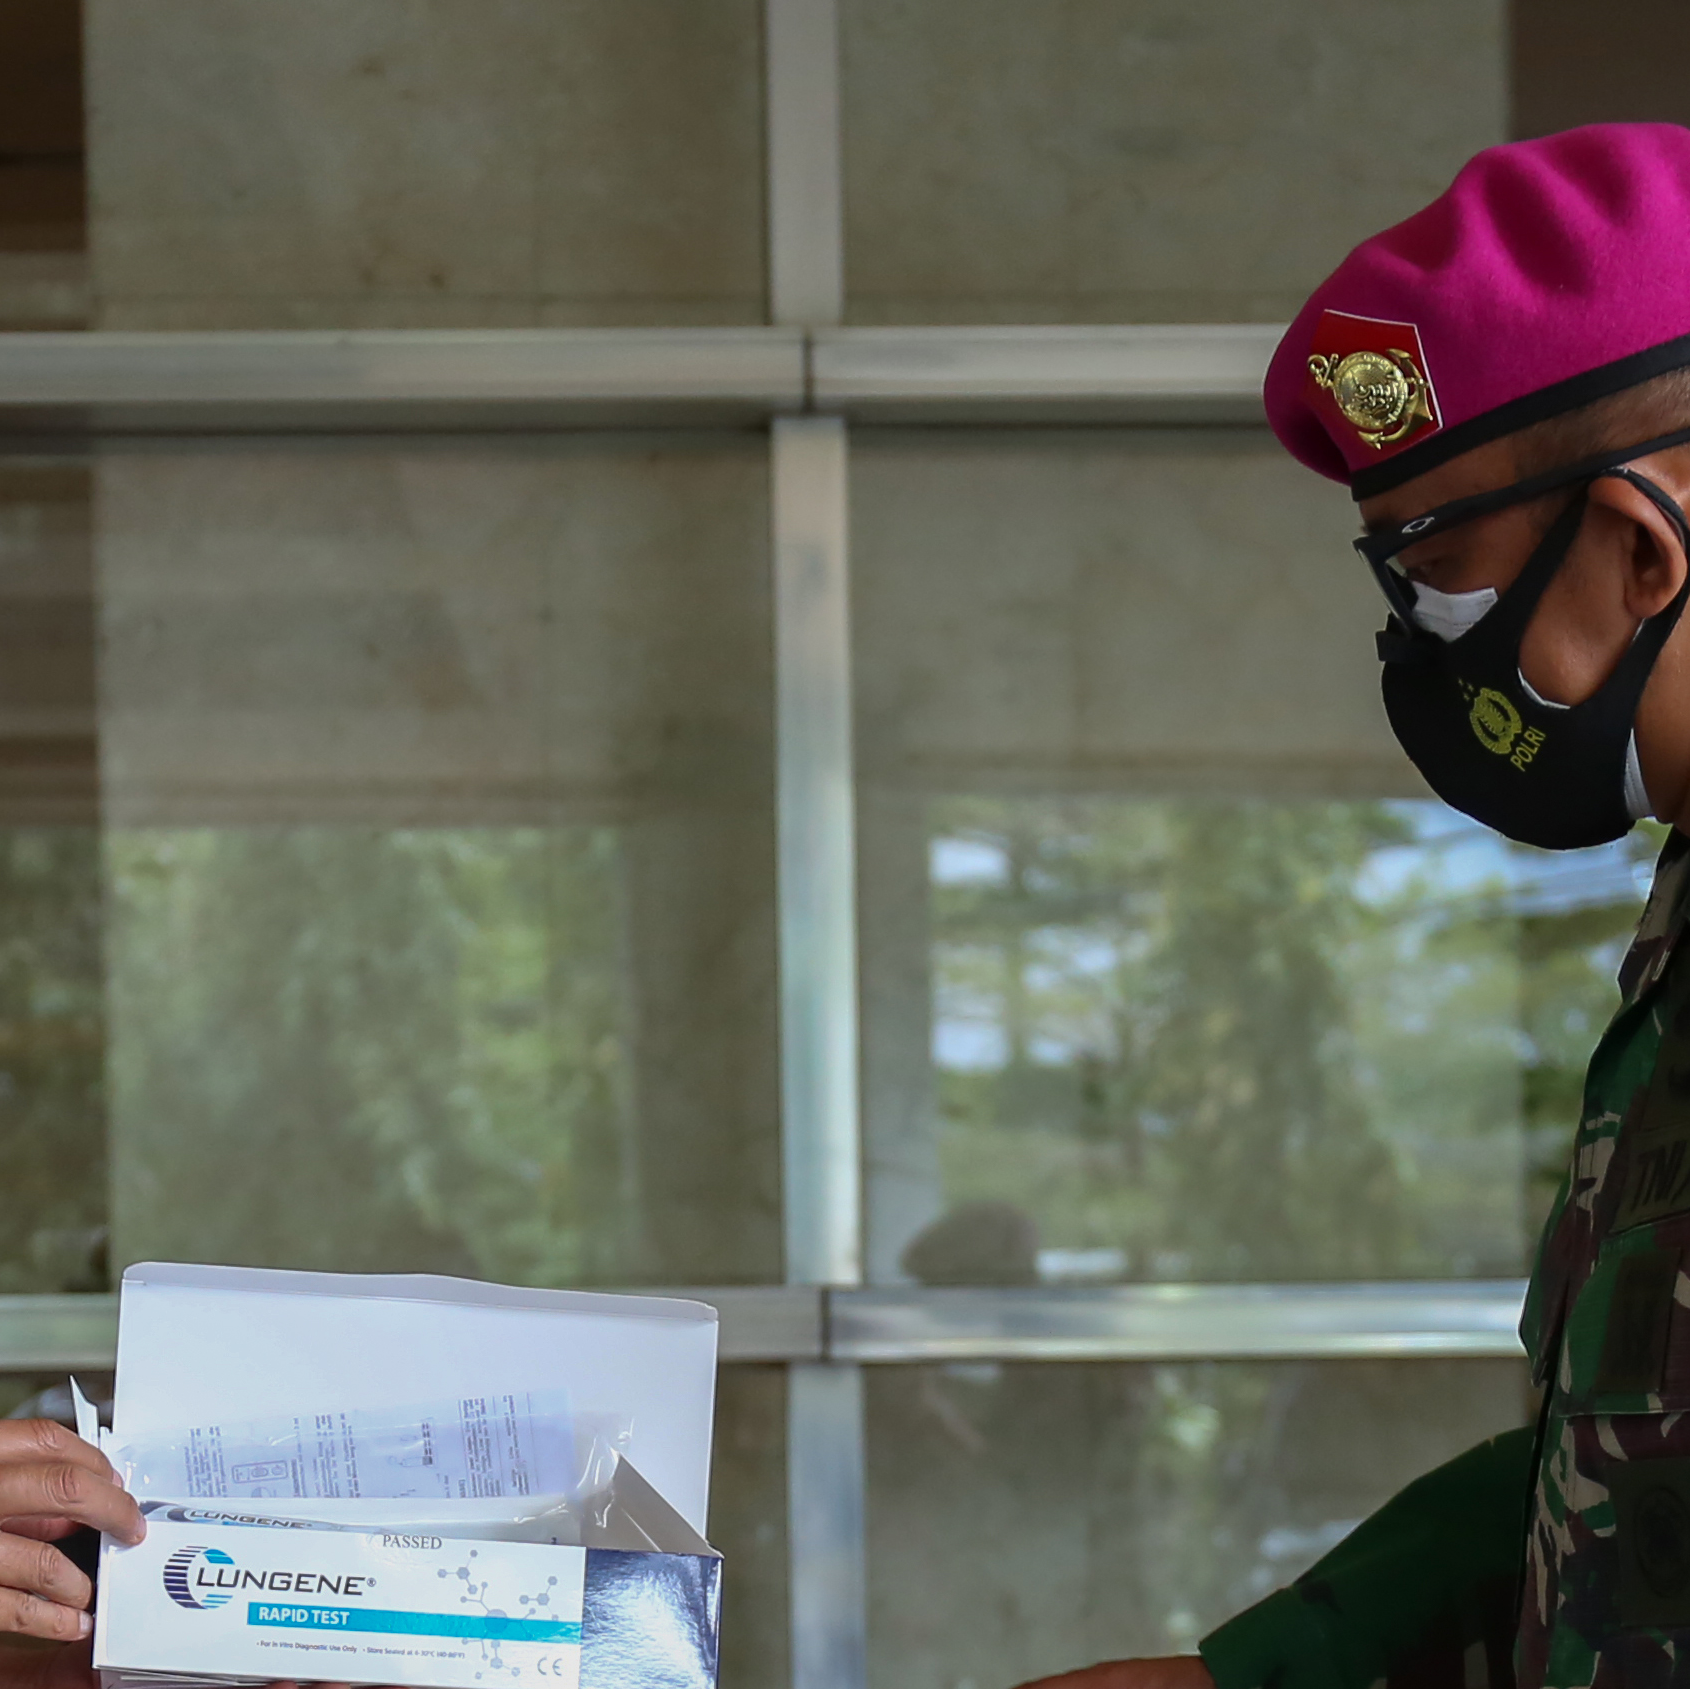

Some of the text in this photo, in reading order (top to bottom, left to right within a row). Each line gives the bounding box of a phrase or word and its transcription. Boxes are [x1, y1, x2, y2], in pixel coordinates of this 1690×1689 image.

[1510, 725, 1547, 772] POLRI
[382, 1534, 443, 1551] PASSED
[258, 1606, 350, 1626] RAPID TEST
